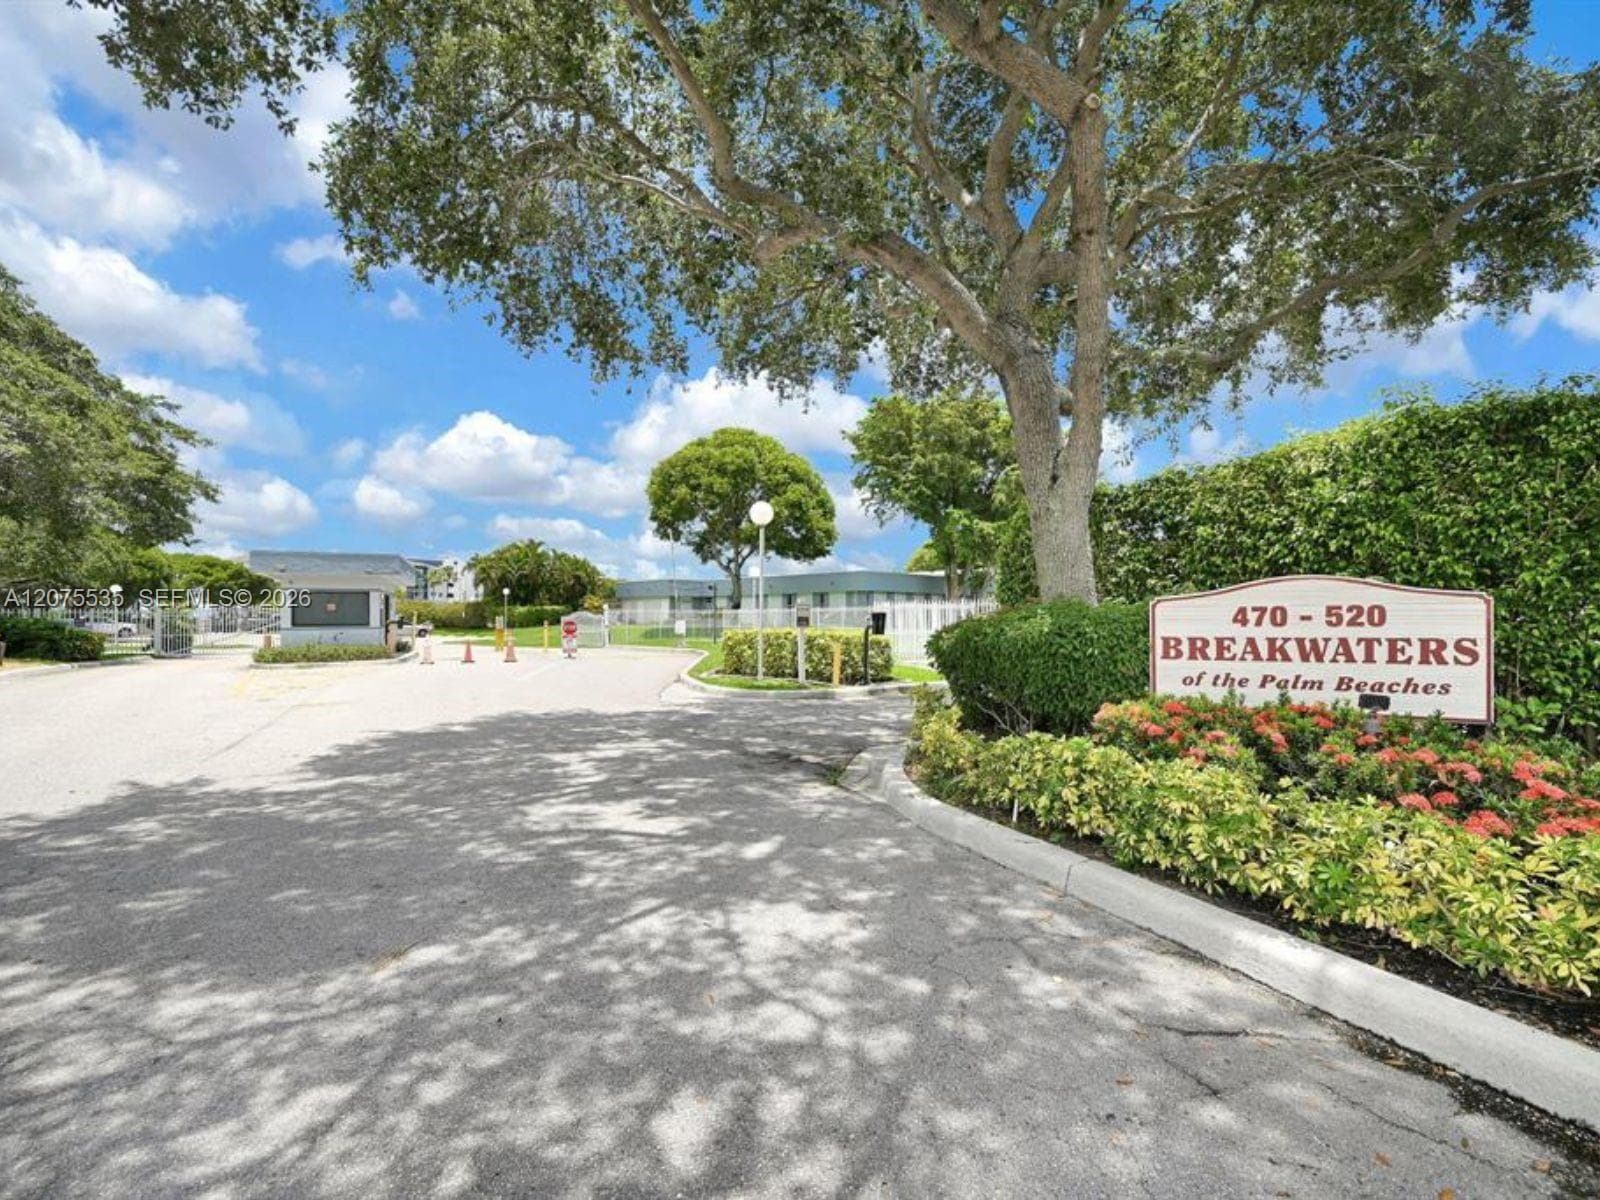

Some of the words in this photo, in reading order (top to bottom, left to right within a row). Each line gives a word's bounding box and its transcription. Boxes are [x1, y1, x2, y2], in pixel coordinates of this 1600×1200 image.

[1232, 605, 1288, 627] 470
[1324, 605, 1387, 627] 520
[1160, 636, 1480, 666] BREAKWATERS
[1182, 671, 1207, 687] of
[1212, 672, 1249, 688] the
[1258, 674, 1324, 691] Palm
[1333, 677, 1452, 695] Beaches
